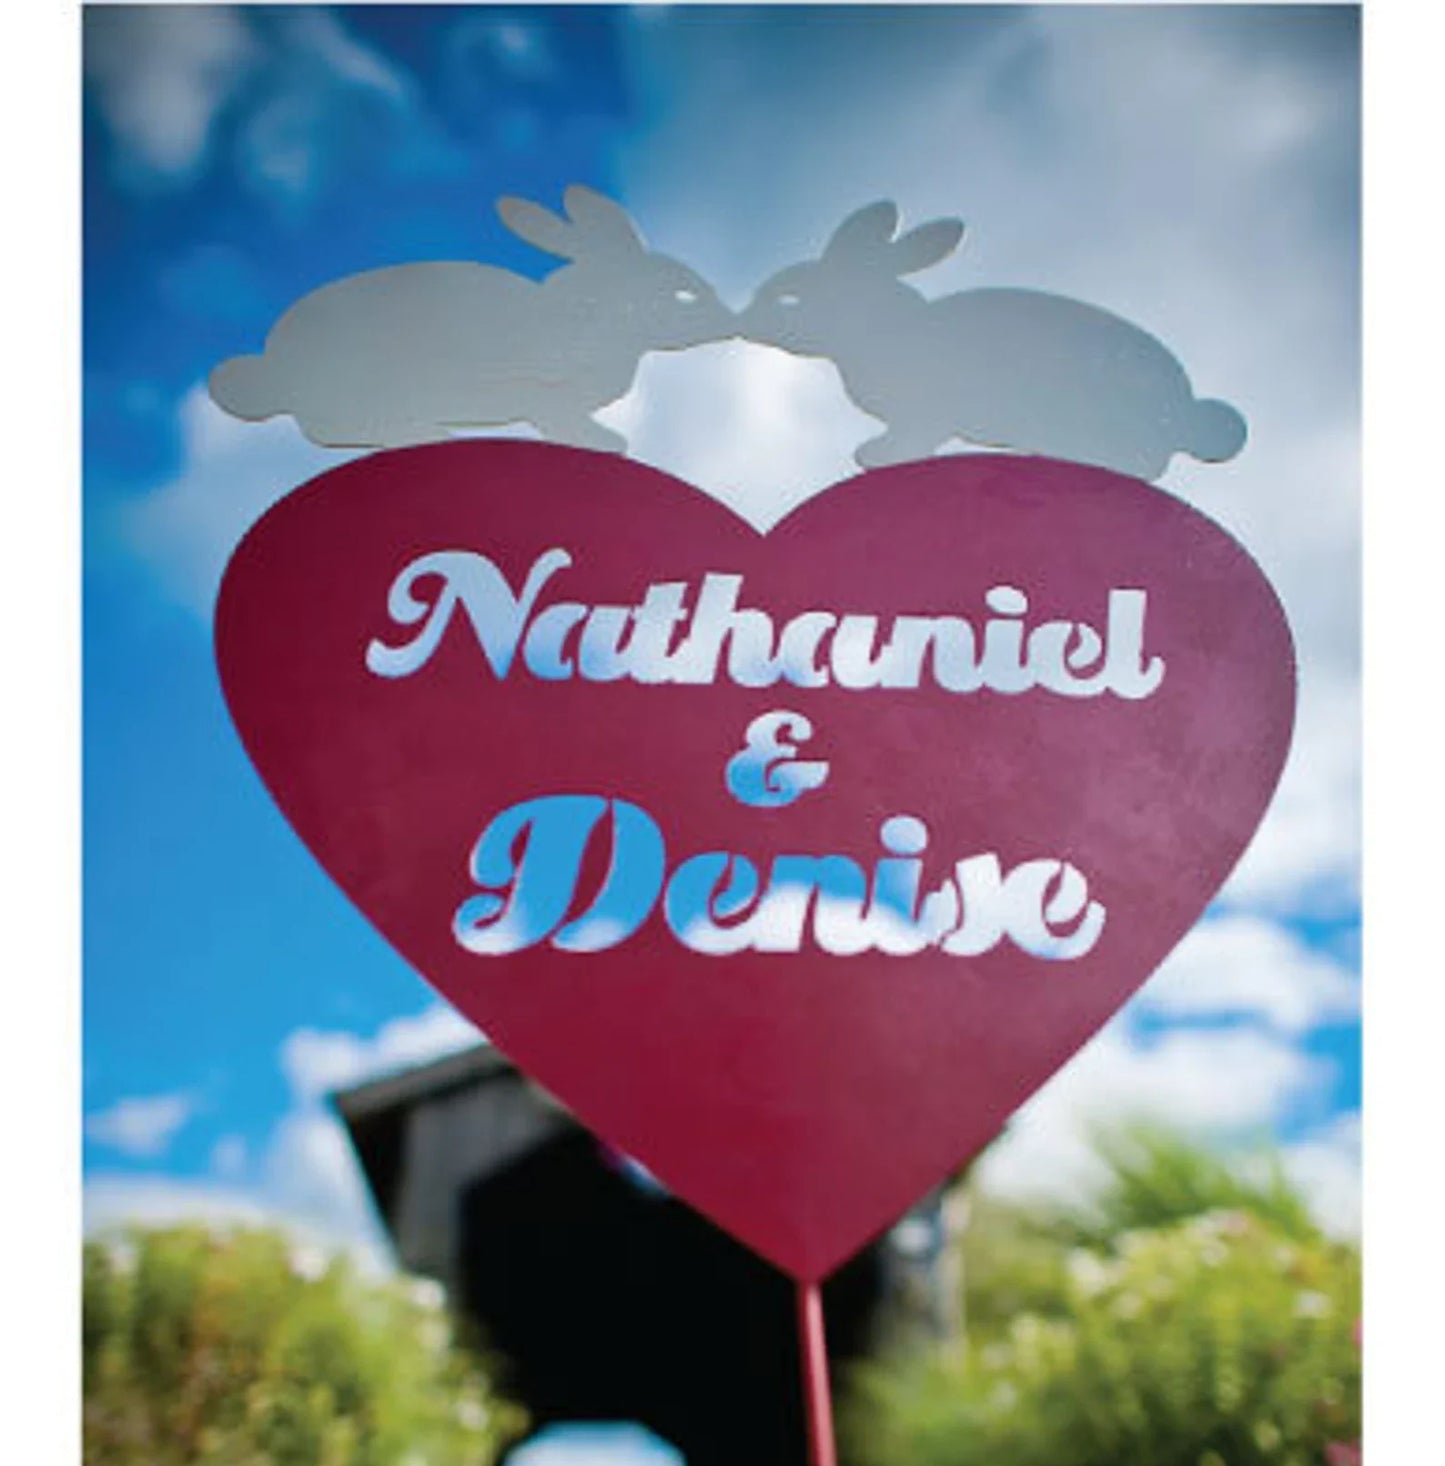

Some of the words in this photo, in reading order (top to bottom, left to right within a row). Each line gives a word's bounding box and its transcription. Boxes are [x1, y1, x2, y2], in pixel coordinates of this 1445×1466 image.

[365, 547, 1165, 700] Nathaniel
[725, 710, 829, 807] &
[451, 793, 1107, 960] Denise
